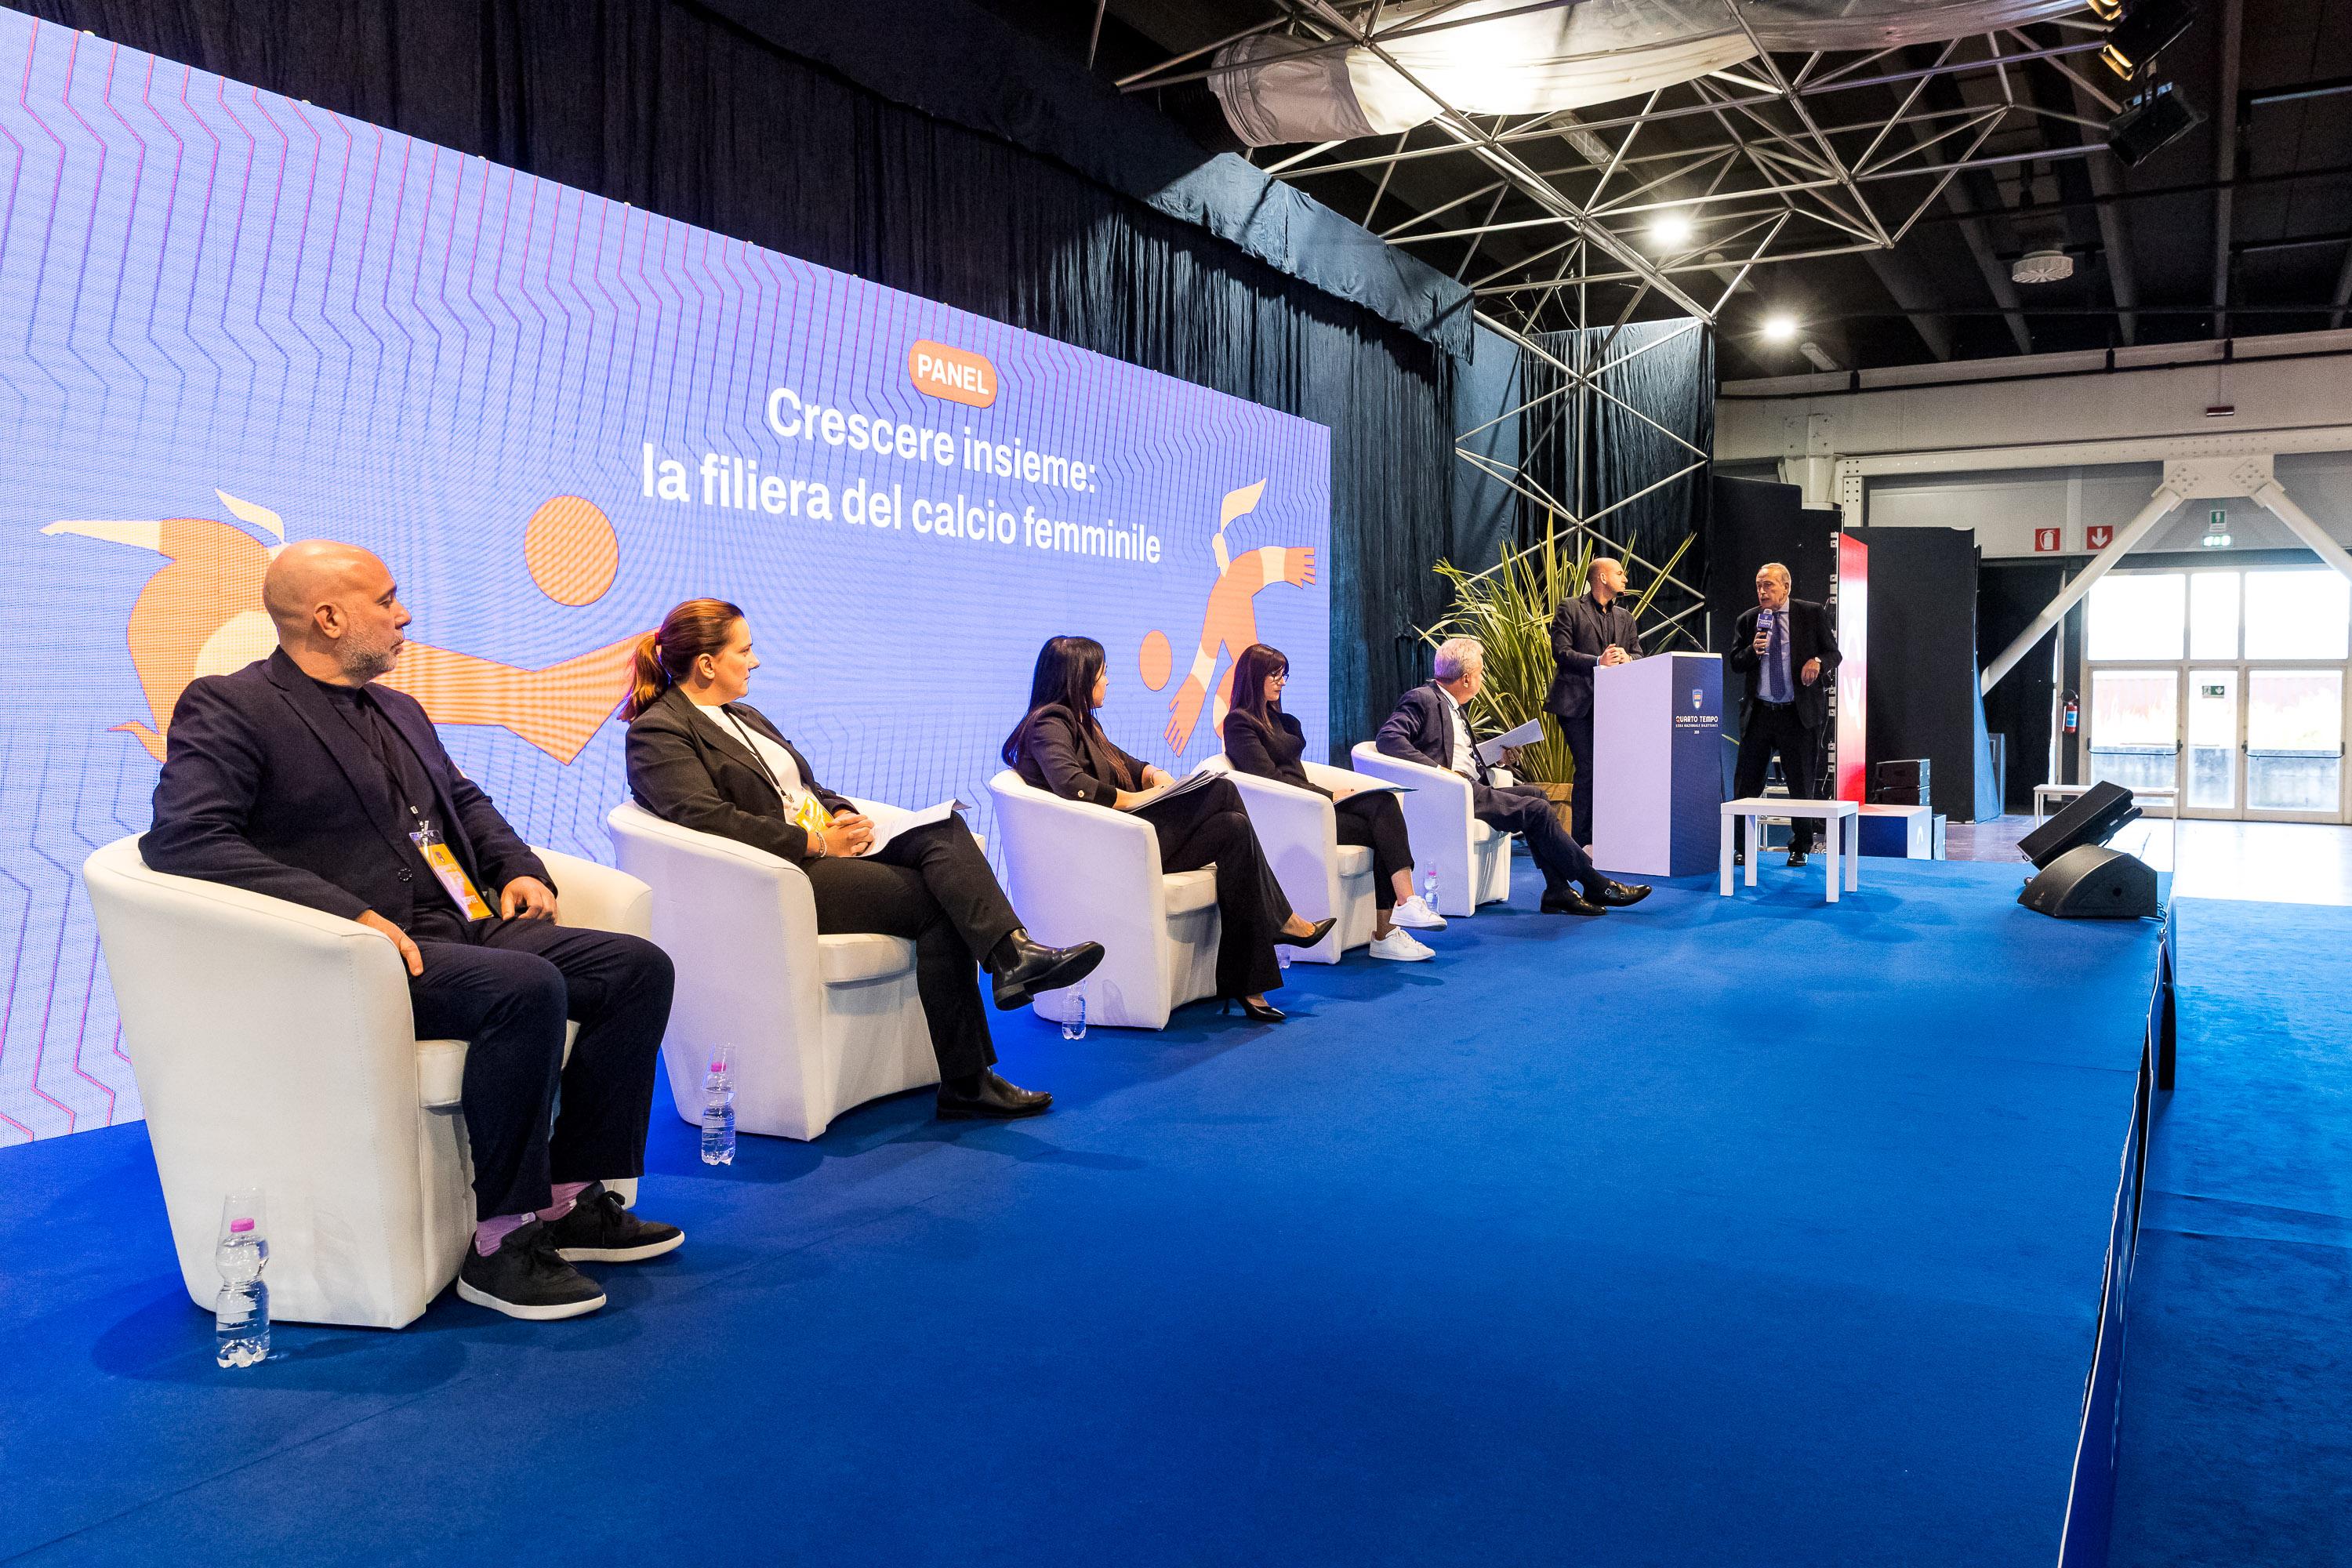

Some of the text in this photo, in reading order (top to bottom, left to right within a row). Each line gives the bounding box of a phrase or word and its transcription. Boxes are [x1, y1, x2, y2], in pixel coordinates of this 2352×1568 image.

[917, 354, 989, 395] PANEL
[768, 387, 1096, 493] Crescere insieme:
[643, 442, 1160, 563] la filiera del calcio femminile
